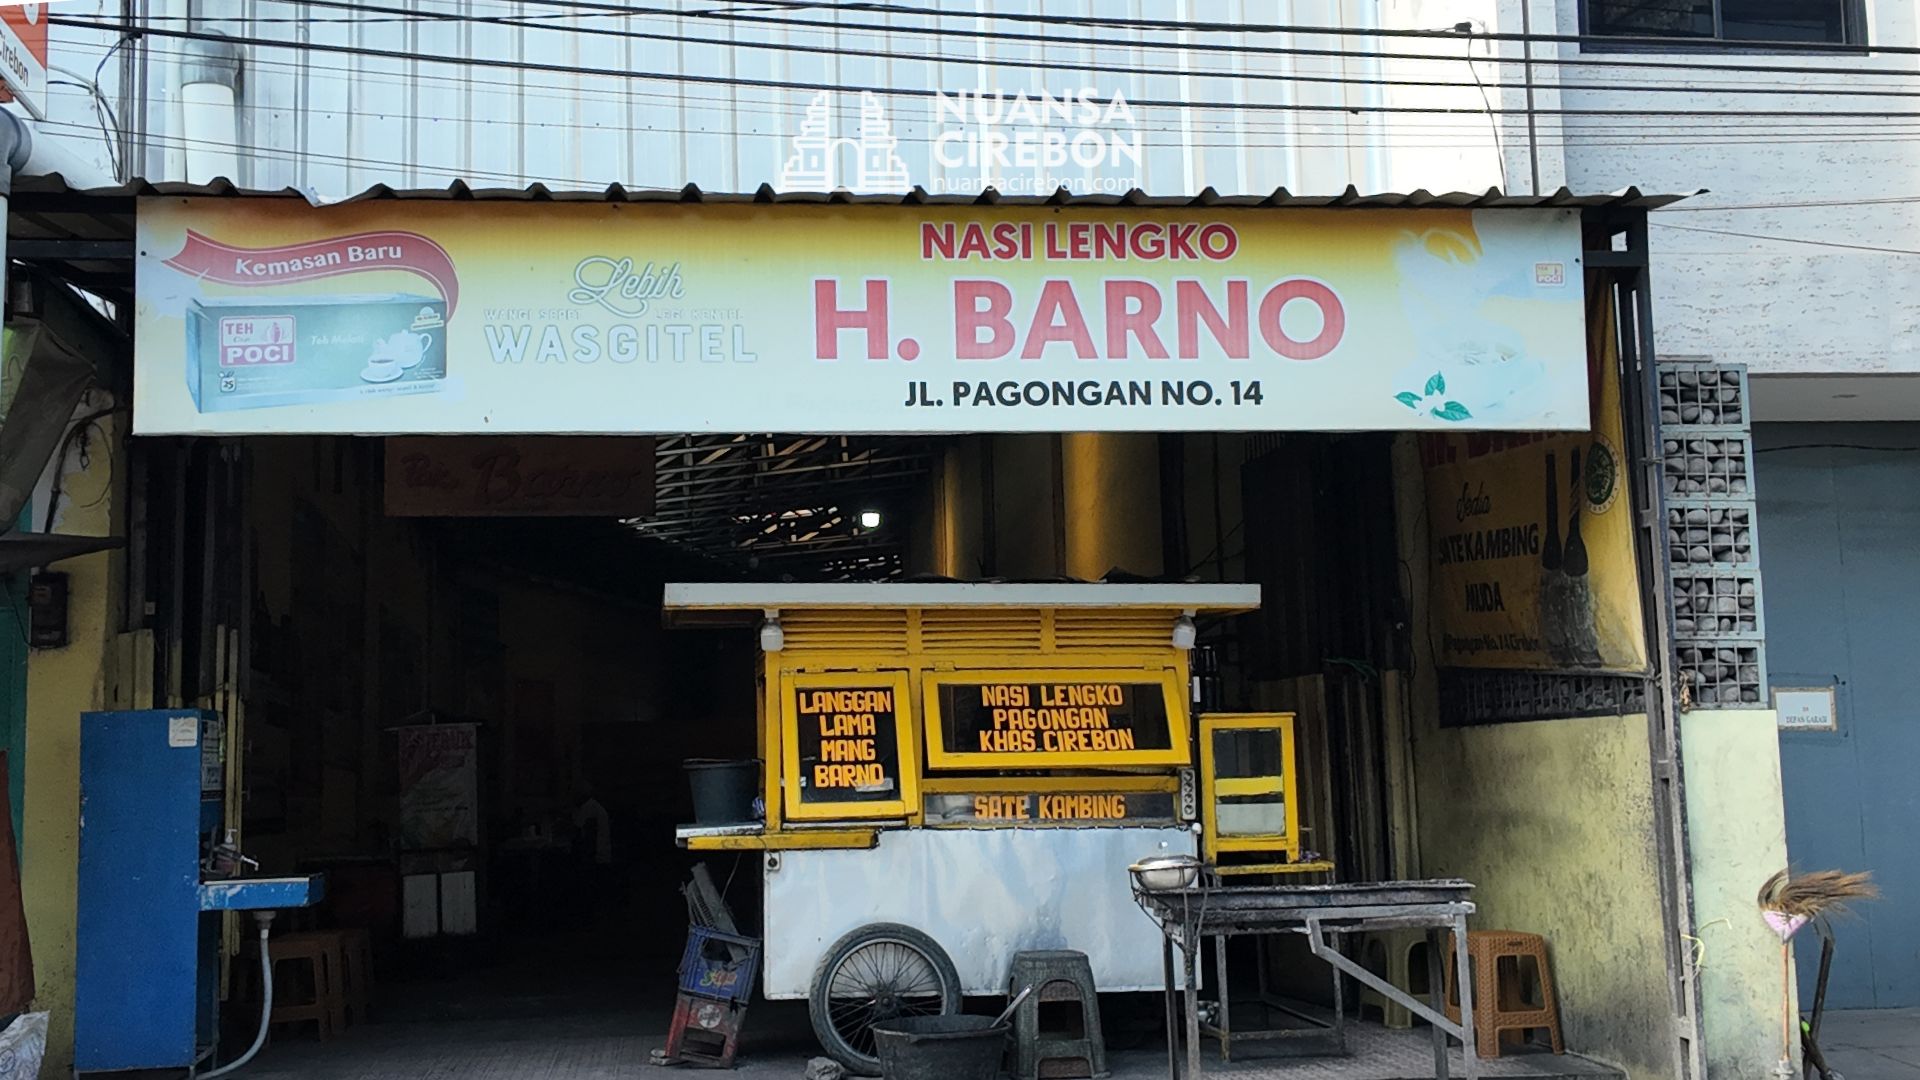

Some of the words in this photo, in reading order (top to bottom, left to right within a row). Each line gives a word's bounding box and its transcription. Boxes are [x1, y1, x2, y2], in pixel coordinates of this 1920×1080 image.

[0, 41, 29, 88] irebon
[922, 223, 1033, 261] NASI
[1047, 223, 1239, 261] LENGKO
[235, 251, 341, 276] Kemasan
[347, 246, 402, 263] Baru
[568, 255, 686, 318] Lebih
[225, 322, 253, 335] TEH
[814, 279, 920, 361] H.
[954, 279, 1346, 361] BARNO
[227, 345, 289, 364] POCI
[484, 324, 758, 363] WASGITEL
[906, 382, 944, 406] JL.
[953, 382, 1151, 406] PAGONGAN
[1161, 382, 1222, 406] NO.
[1231, 381, 1263, 405] 14
[1465, 582, 1506, 613] MUDA
[799, 690, 892, 714] LANGGAN
[981, 685, 1030, 708] NASI
[1041, 685, 1124, 706] LENGKO
[820, 715, 876, 737] LAMA
[993, 708, 1109, 730] PAGONGAN
[821, 739, 876, 762] MANG
[980, 729, 1037, 753] KHAS
[1043, 728, 1135, 752] CIREBON
[814, 763, 885, 788] BARNO
[974, 796, 1028, 820] SATE
[1039, 795, 1126, 820] KAMBING
